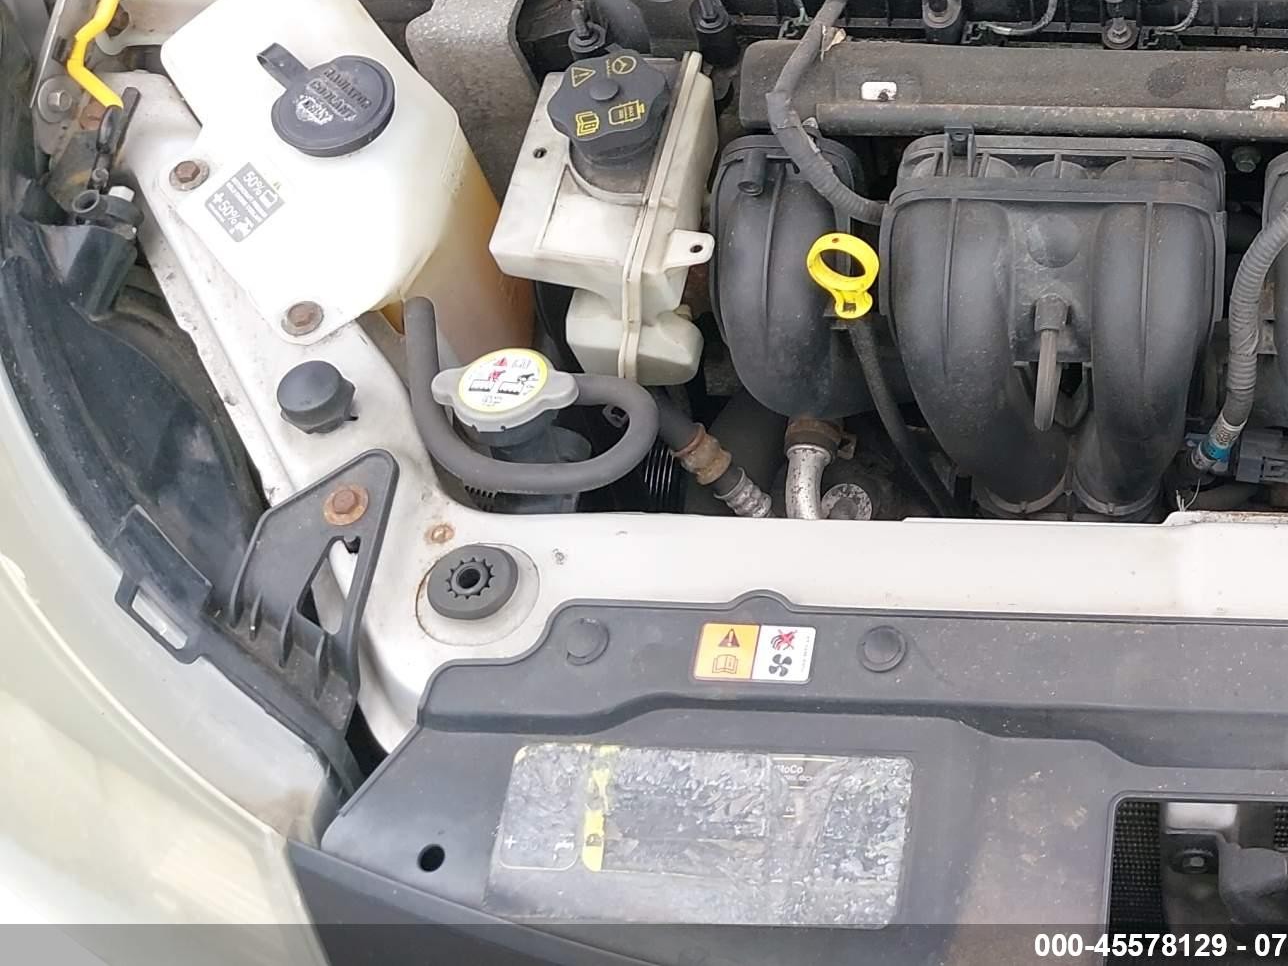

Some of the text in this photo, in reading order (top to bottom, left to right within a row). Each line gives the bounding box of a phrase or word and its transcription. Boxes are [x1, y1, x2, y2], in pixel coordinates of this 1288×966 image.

[309, 79, 357, 119] COOLANT
[323, 67, 372, 110] RADIATOR
[243, 171, 265, 196] 50%
